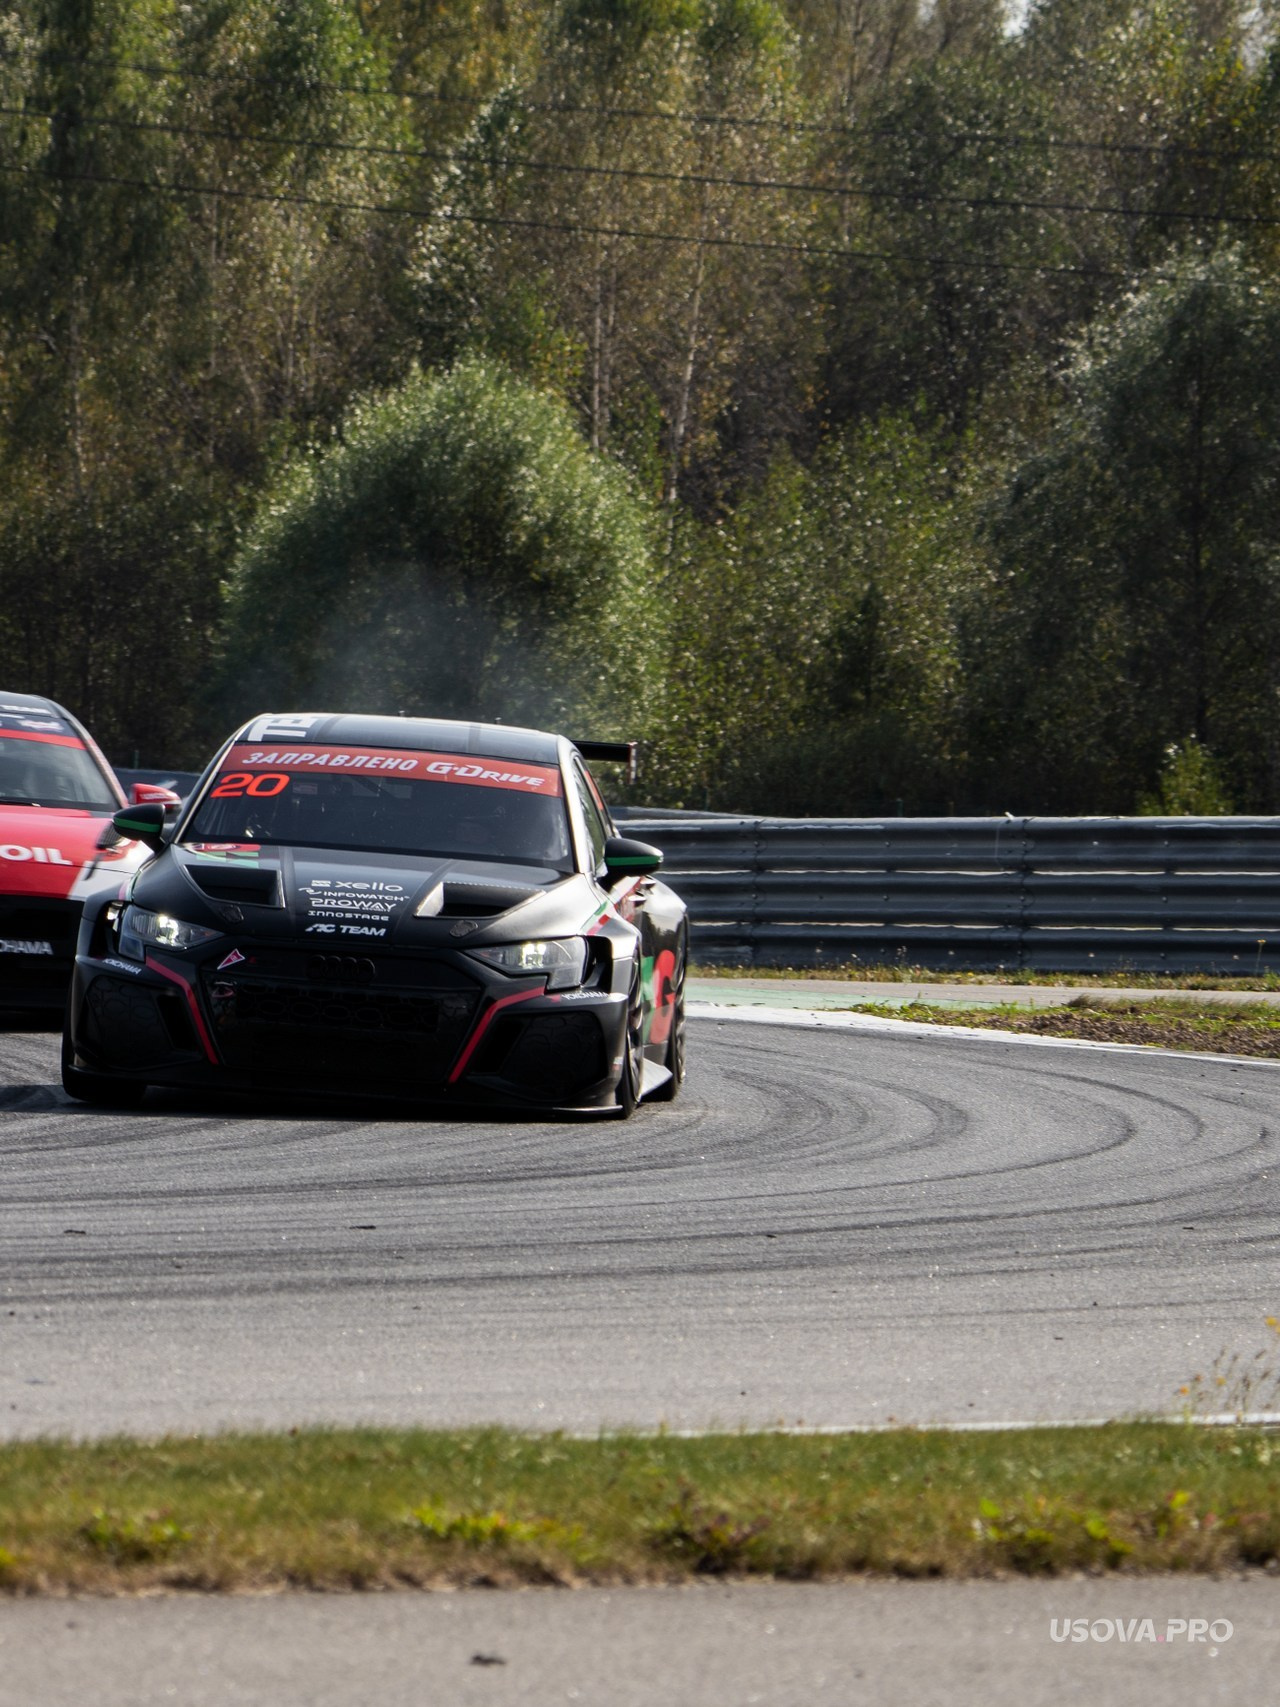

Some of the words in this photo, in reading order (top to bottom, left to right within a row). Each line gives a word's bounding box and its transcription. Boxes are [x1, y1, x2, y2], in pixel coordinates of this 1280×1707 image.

[242, 753, 419, 771] ЗАПРАВЛЕНО
[210, 773, 290, 798] 20
[334, 881, 403, 892] xello
[340, 925, 386, 936] TEAM
